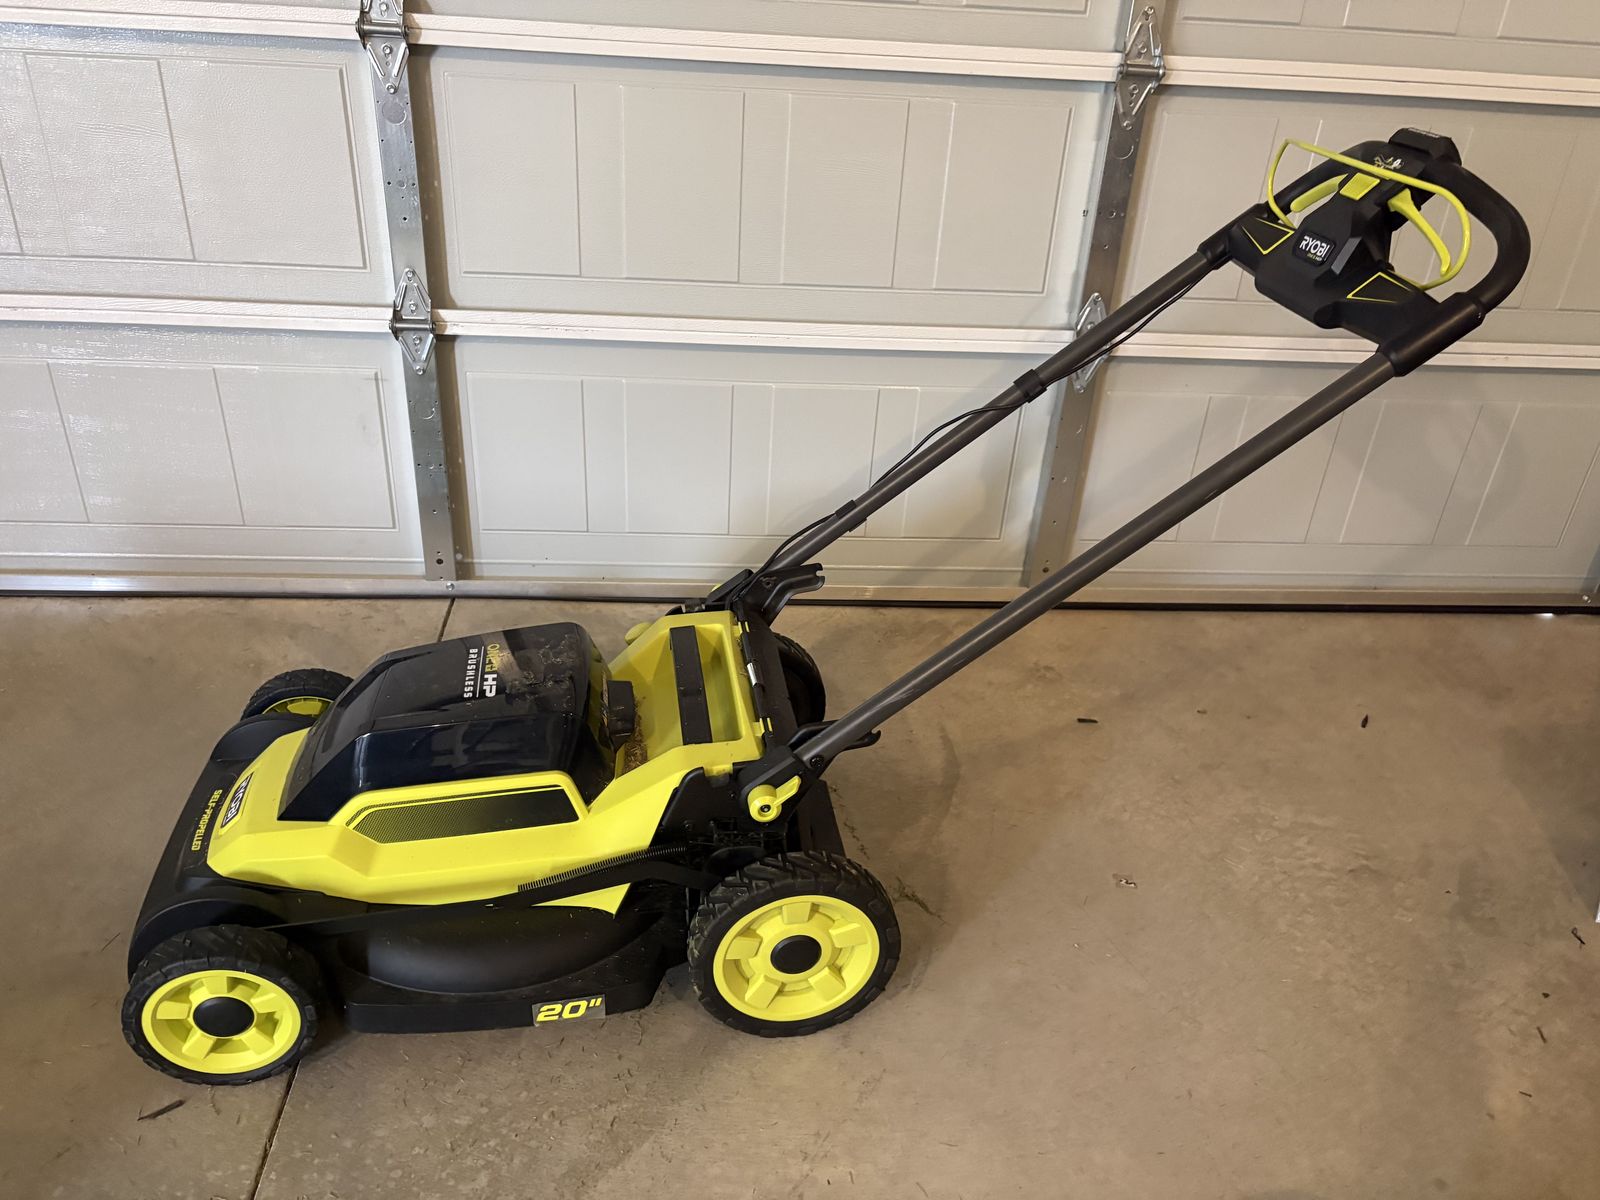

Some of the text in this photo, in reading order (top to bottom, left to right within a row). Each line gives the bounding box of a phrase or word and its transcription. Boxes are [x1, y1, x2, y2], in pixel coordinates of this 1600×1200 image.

[1299, 235, 1330, 258] RYOBI
[463, 648, 478, 698] BRUSHLESS
[482, 673, 498, 698] HP
[191, 789, 223, 851] SELF-PROPELLED
[536, 997, 603, 1022] 20"
